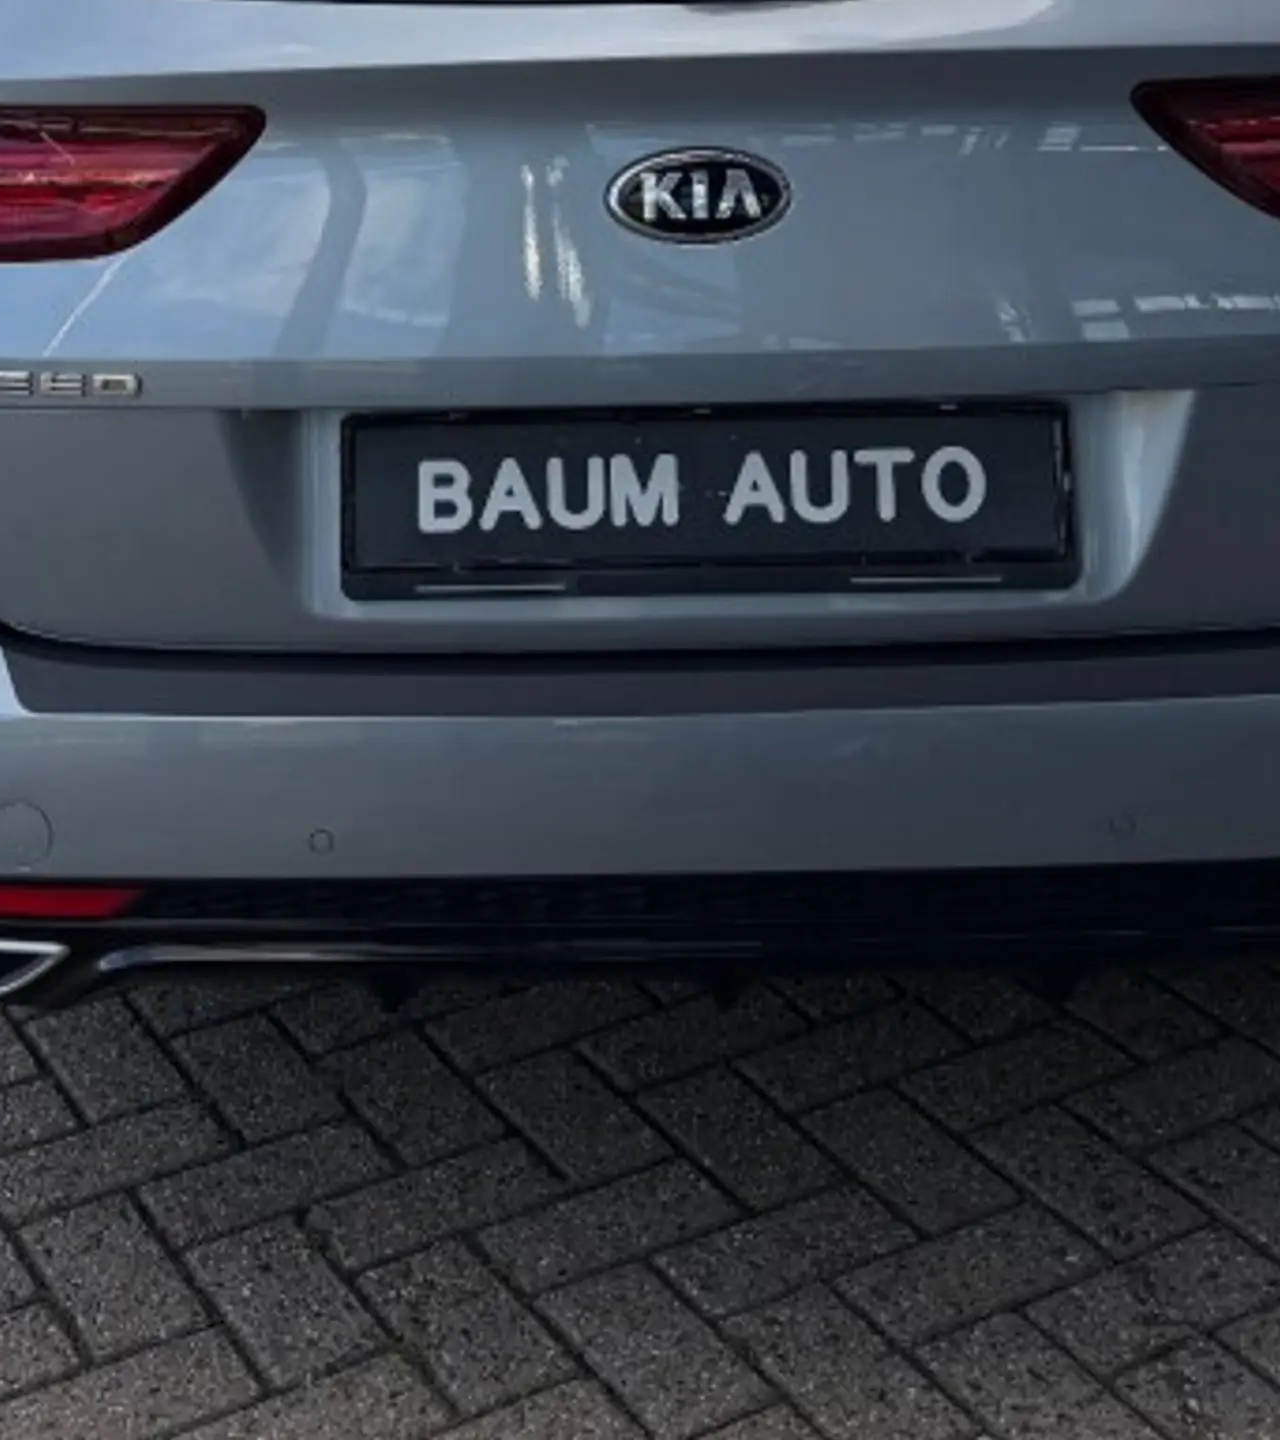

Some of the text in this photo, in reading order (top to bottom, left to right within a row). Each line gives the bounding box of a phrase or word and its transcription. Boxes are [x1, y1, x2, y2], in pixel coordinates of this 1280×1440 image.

[640, 168, 761, 222] KIA
[417, 446, 987, 533] BAUM AUTO
